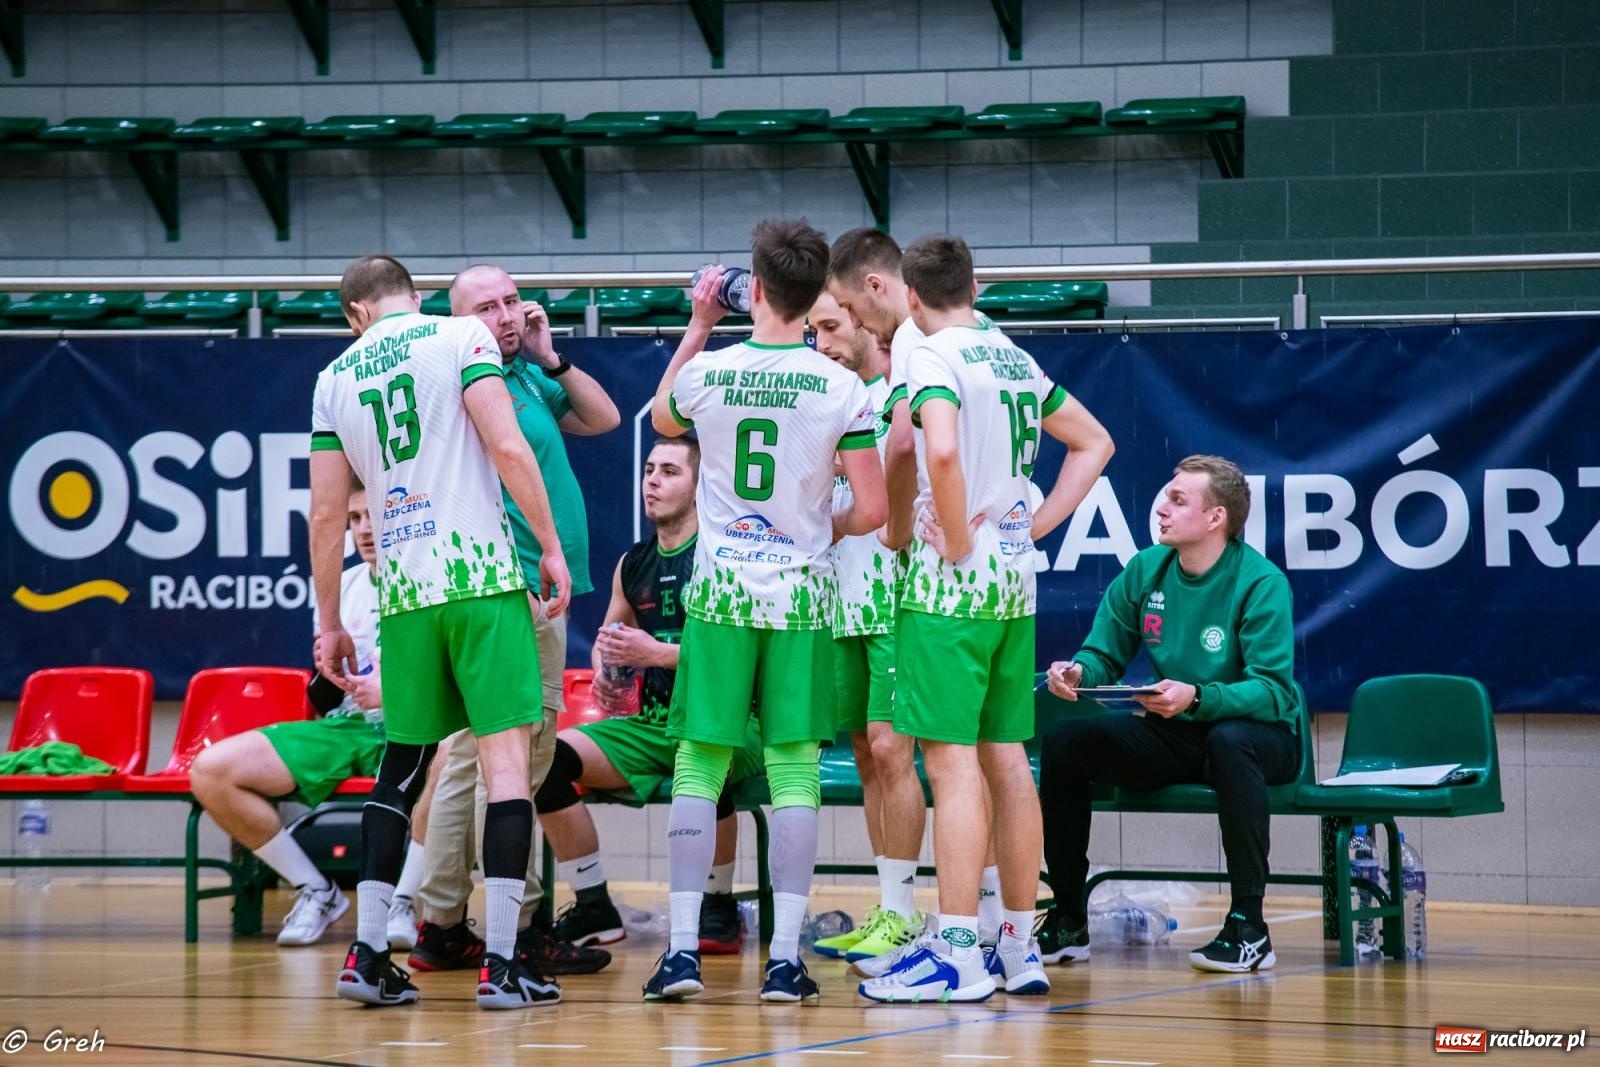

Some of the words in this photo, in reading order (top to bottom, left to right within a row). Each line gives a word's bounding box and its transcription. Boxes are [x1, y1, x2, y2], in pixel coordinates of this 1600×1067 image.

[724, 388, 799, 409] RACIBÓRZ
[740, 370, 829, 394] SIATKARSKI
[359, 373, 421, 471] 13
[1000, 390, 1039, 478] 16
[734, 418, 778, 501] 6
[150, 564, 316, 610] RACIBÓ
[1143, 613, 1163, 636] R
